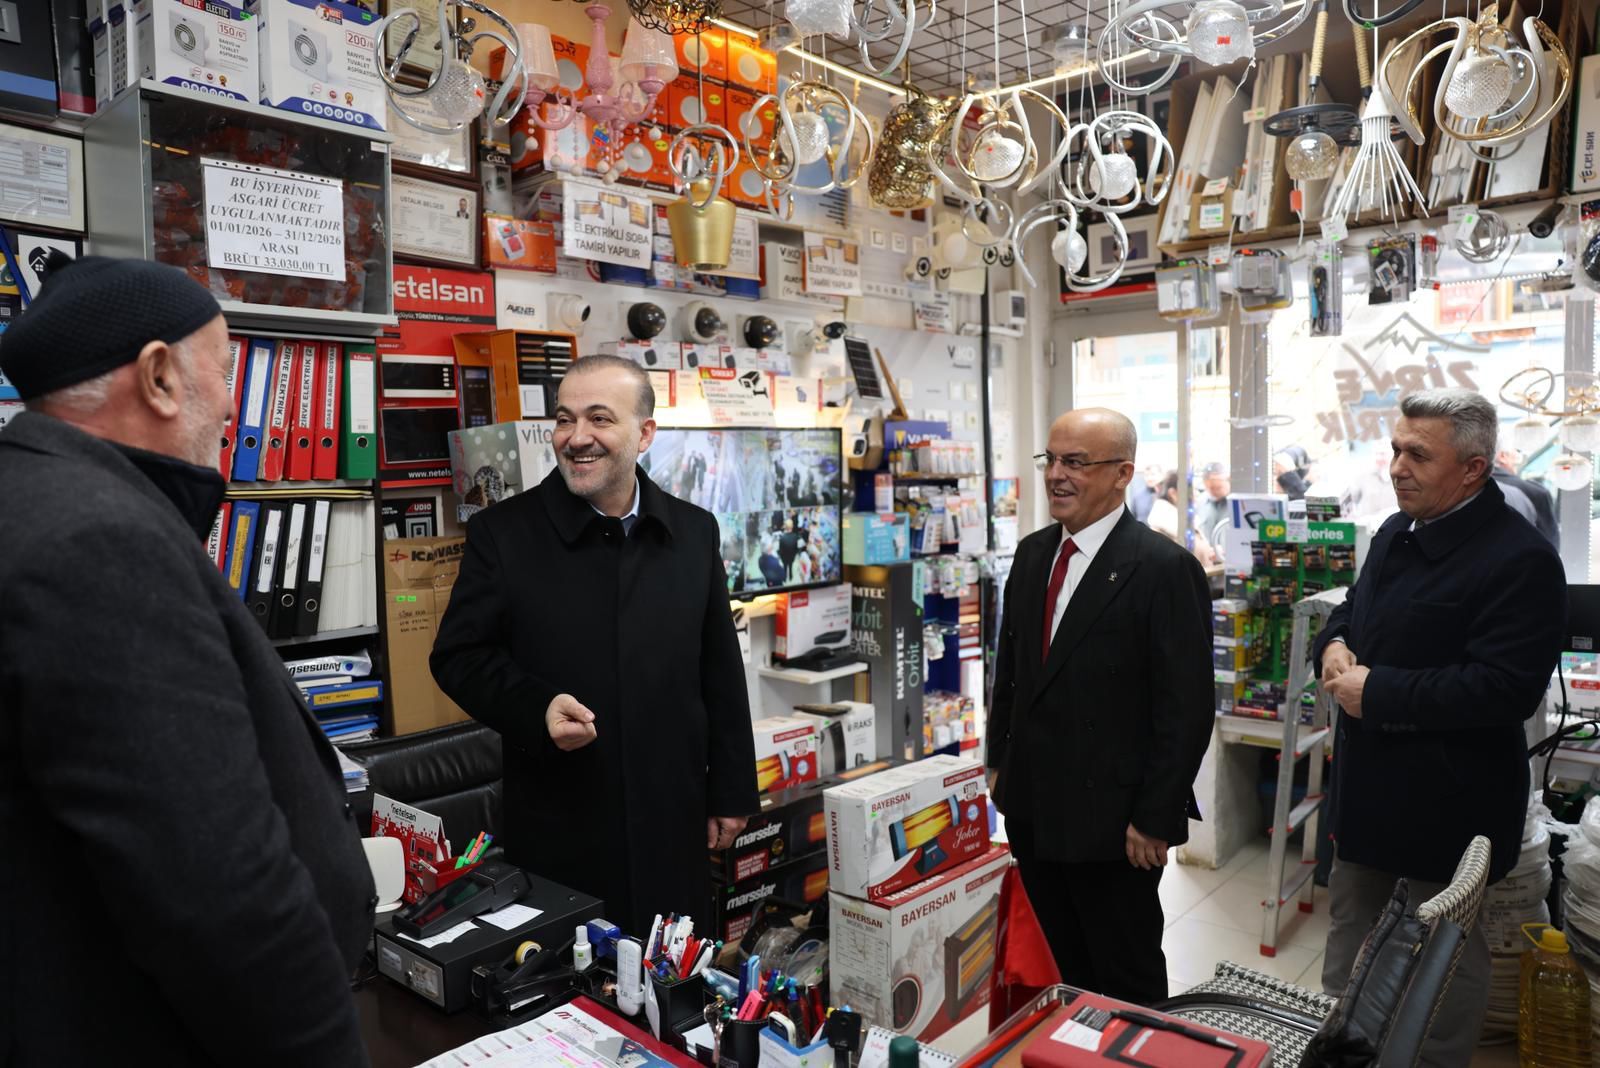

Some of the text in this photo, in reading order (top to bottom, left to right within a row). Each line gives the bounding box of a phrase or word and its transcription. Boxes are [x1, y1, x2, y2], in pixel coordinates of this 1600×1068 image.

[230, 177, 322, 200] BU İŞYERİNDE
[228, 193, 324, 214] ASGARİ ÜCRET
[210, 205, 341, 231] UYGULANMAKTADIR
[210, 221, 272, 238] 01/01/2026
[285, 230, 342, 246] 31/12/2026
[575, 222, 649, 244] ELEKTRİKLİ SOBA
[260, 242, 299, 256] ARASI
[575, 239, 640, 260] TAMİRİ YAPILIR
[223, 252, 335, 274] BRÜT 33.030,00 TL
[281, 345, 293, 372] ZİRVE
[303, 359, 312, 401] ELEKTRİK
[277, 374, 288, 416] ELEKTRİK
[300, 404, 309, 428] ZİRVE
[1265, 525, 1284, 538] GP
[896, 626, 905, 700] KUMTEL
[904, 641, 920, 688] Orbit
[871, 791, 911, 813] BAYERSAN
[735, 822, 783, 849] marsstar
[830, 811, 840, 872] BAYERSAN
[952, 823, 981, 849] Joker
[726, 882, 777, 912] marsstar
[901, 889, 957, 928] BAYERSAN
[841, 908, 883, 929] BAYERSAN
